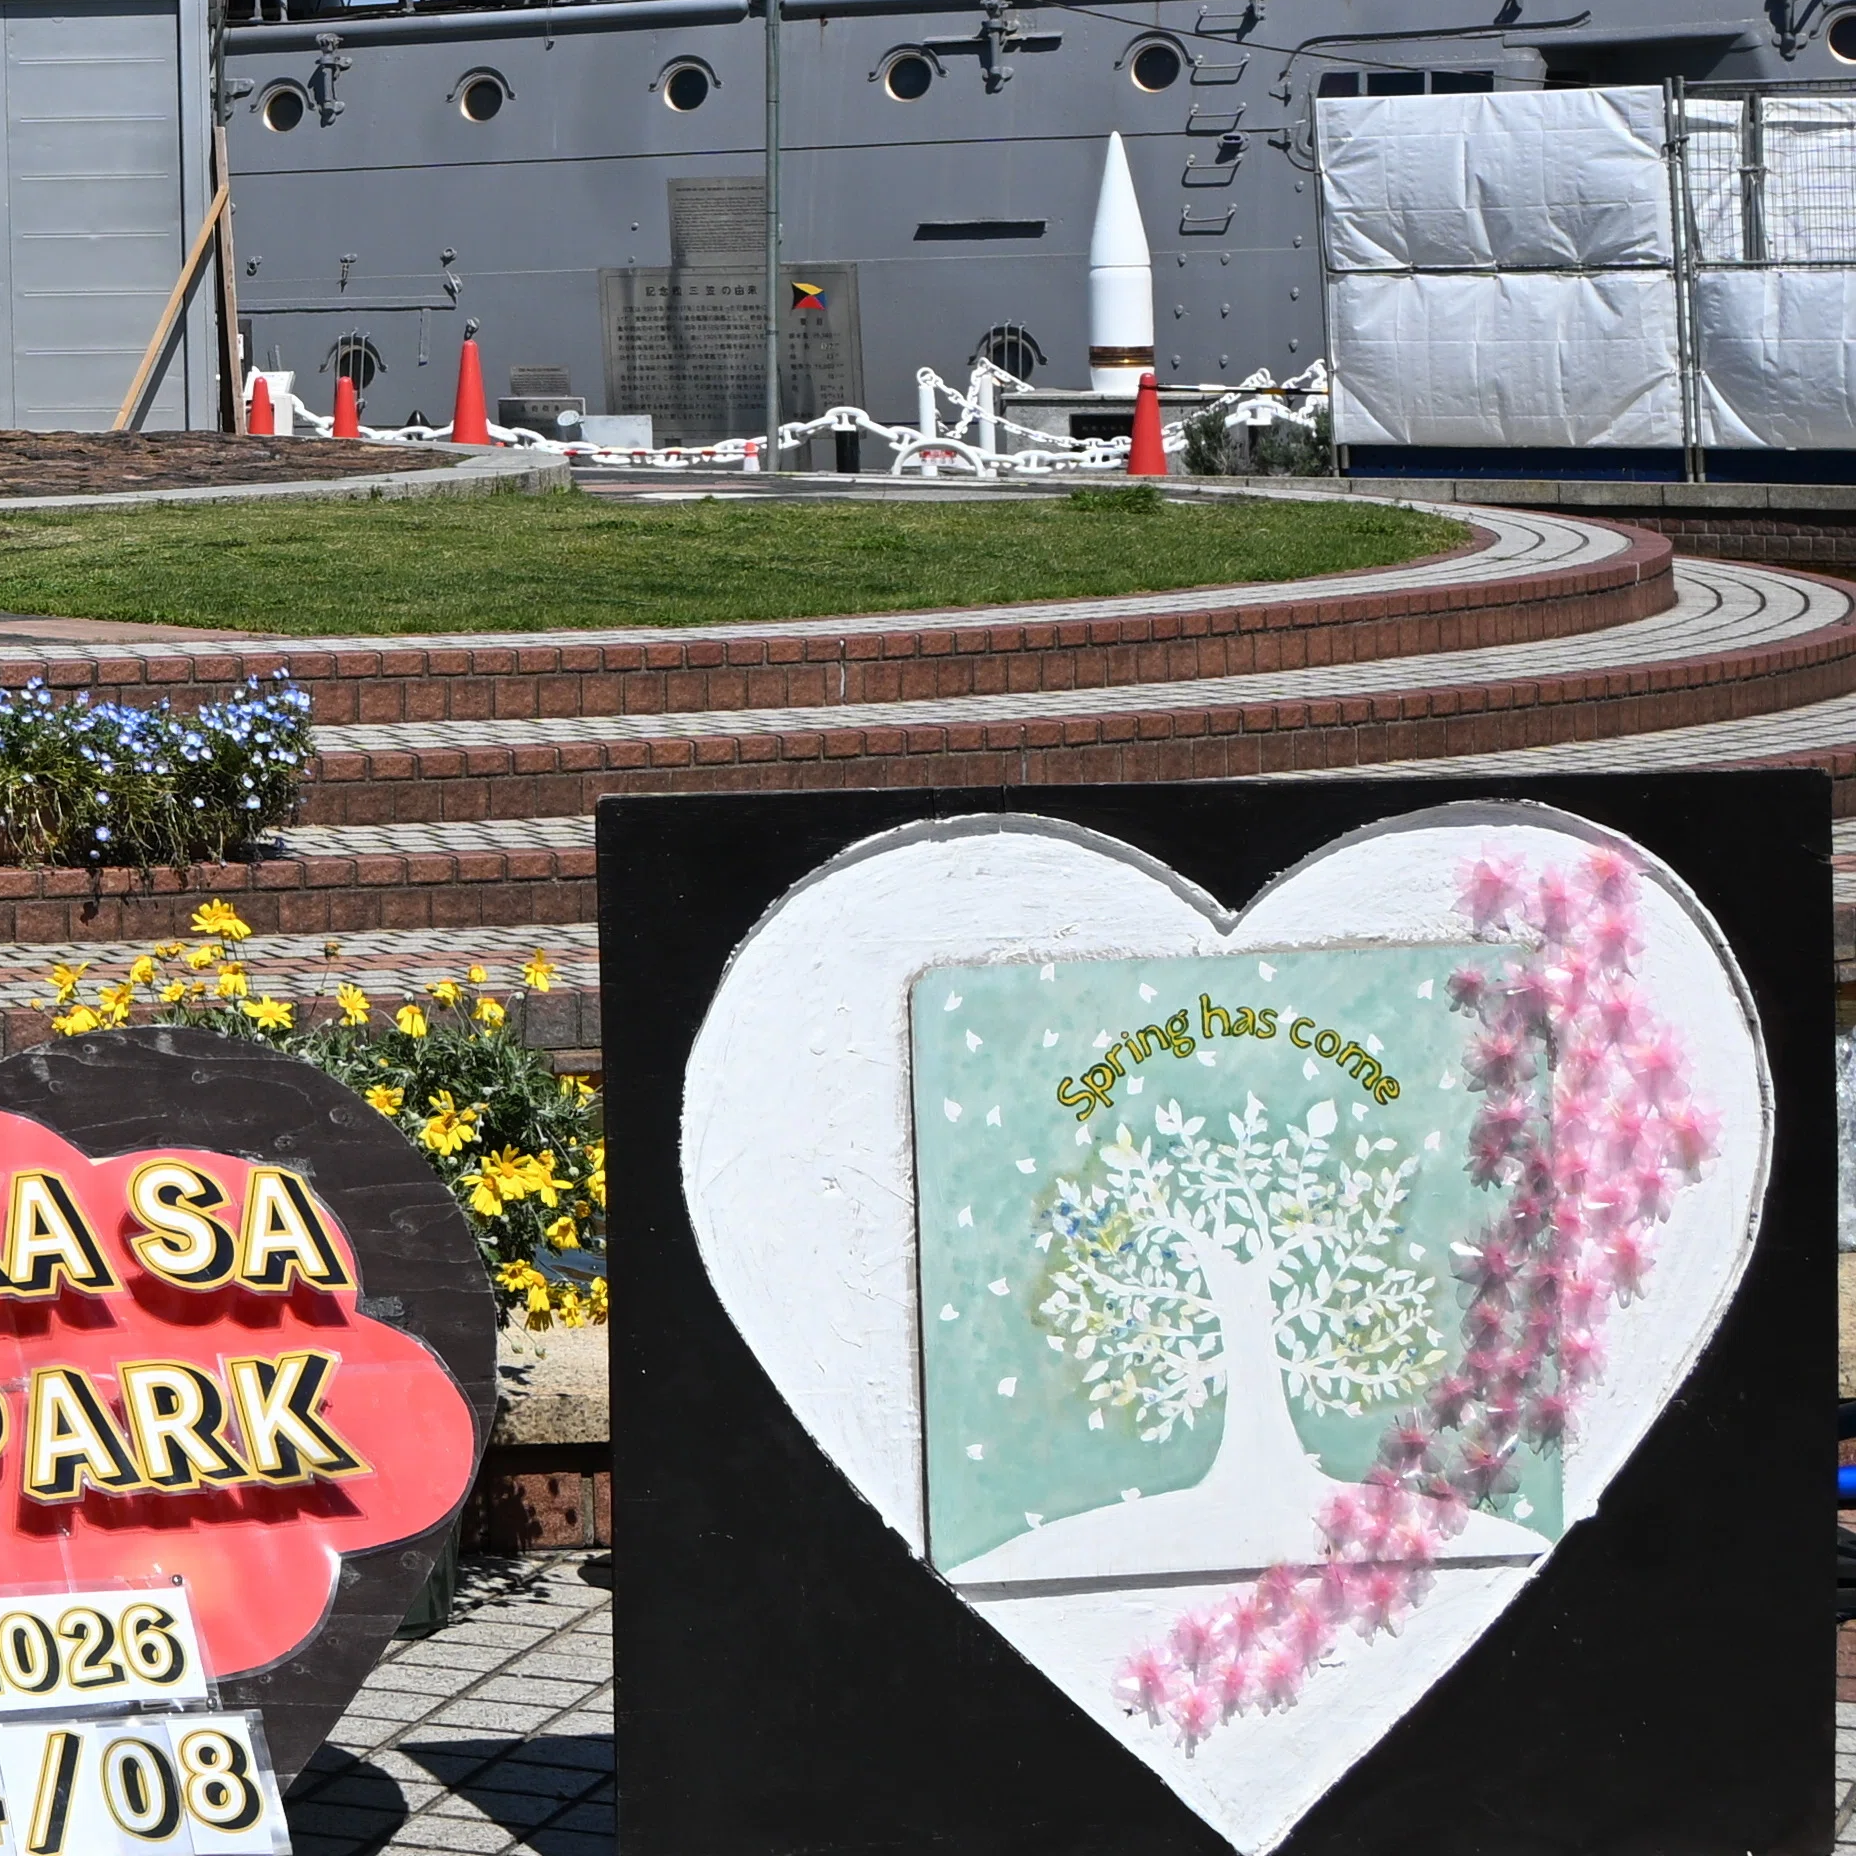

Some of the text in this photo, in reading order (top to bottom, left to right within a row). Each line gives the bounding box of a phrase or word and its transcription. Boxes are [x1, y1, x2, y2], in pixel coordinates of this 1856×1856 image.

[1057, 993, 1401, 1122] Spring has come
